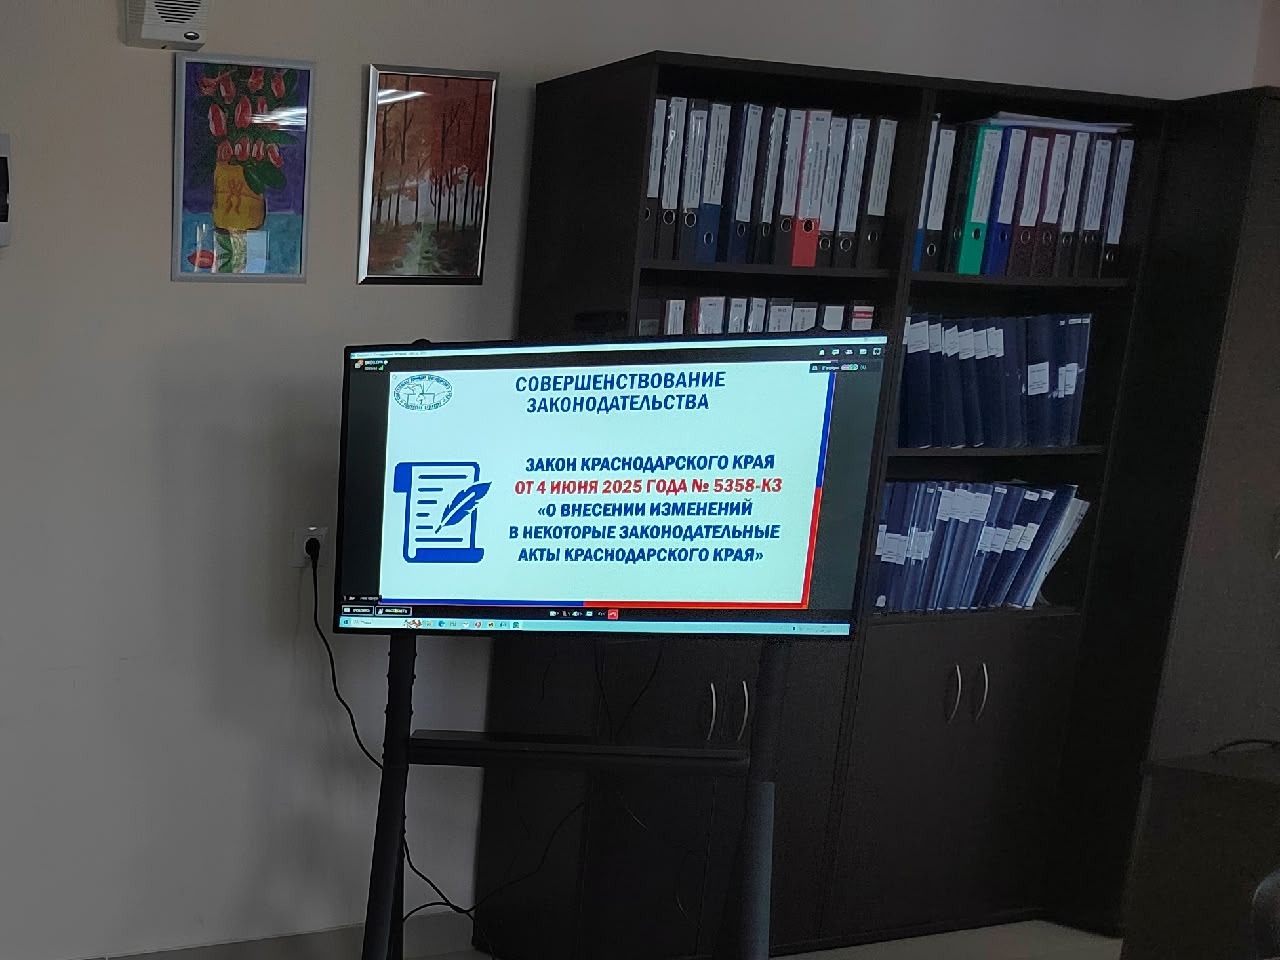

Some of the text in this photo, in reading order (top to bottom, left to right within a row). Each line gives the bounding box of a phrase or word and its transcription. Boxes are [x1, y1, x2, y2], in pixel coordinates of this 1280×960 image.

[515, 371, 727, 392] СОВЕРШЕНСТВОВАНИЕ
[526, 393, 709, 414] ЗАКОНОДАТЕЛЬСТВА
[525, 454, 775, 473] ЗАКОН КРАСНОДАРСКОГО КРАЯ
[514, 480, 534, 495] ОТ
[536, 480, 547, 494] 4
[550, 480, 598, 494] ИЮНЯ
[602, 479, 642, 494] 2025
[646, 478, 688, 495] ГОДА
[691, 478, 709, 493] №
[537, 498, 753, 518] «О ВНЕСЕНИИ ИЗМЕНЕНИЙ
[509, 524, 781, 541] В НЕКОТОРЫЕ ЗАКОНОДАТЕЛЬНЫЕ
[517, 547, 764, 564] АКТЫ КРАСНОДАРСКОГО КРАЯ»
